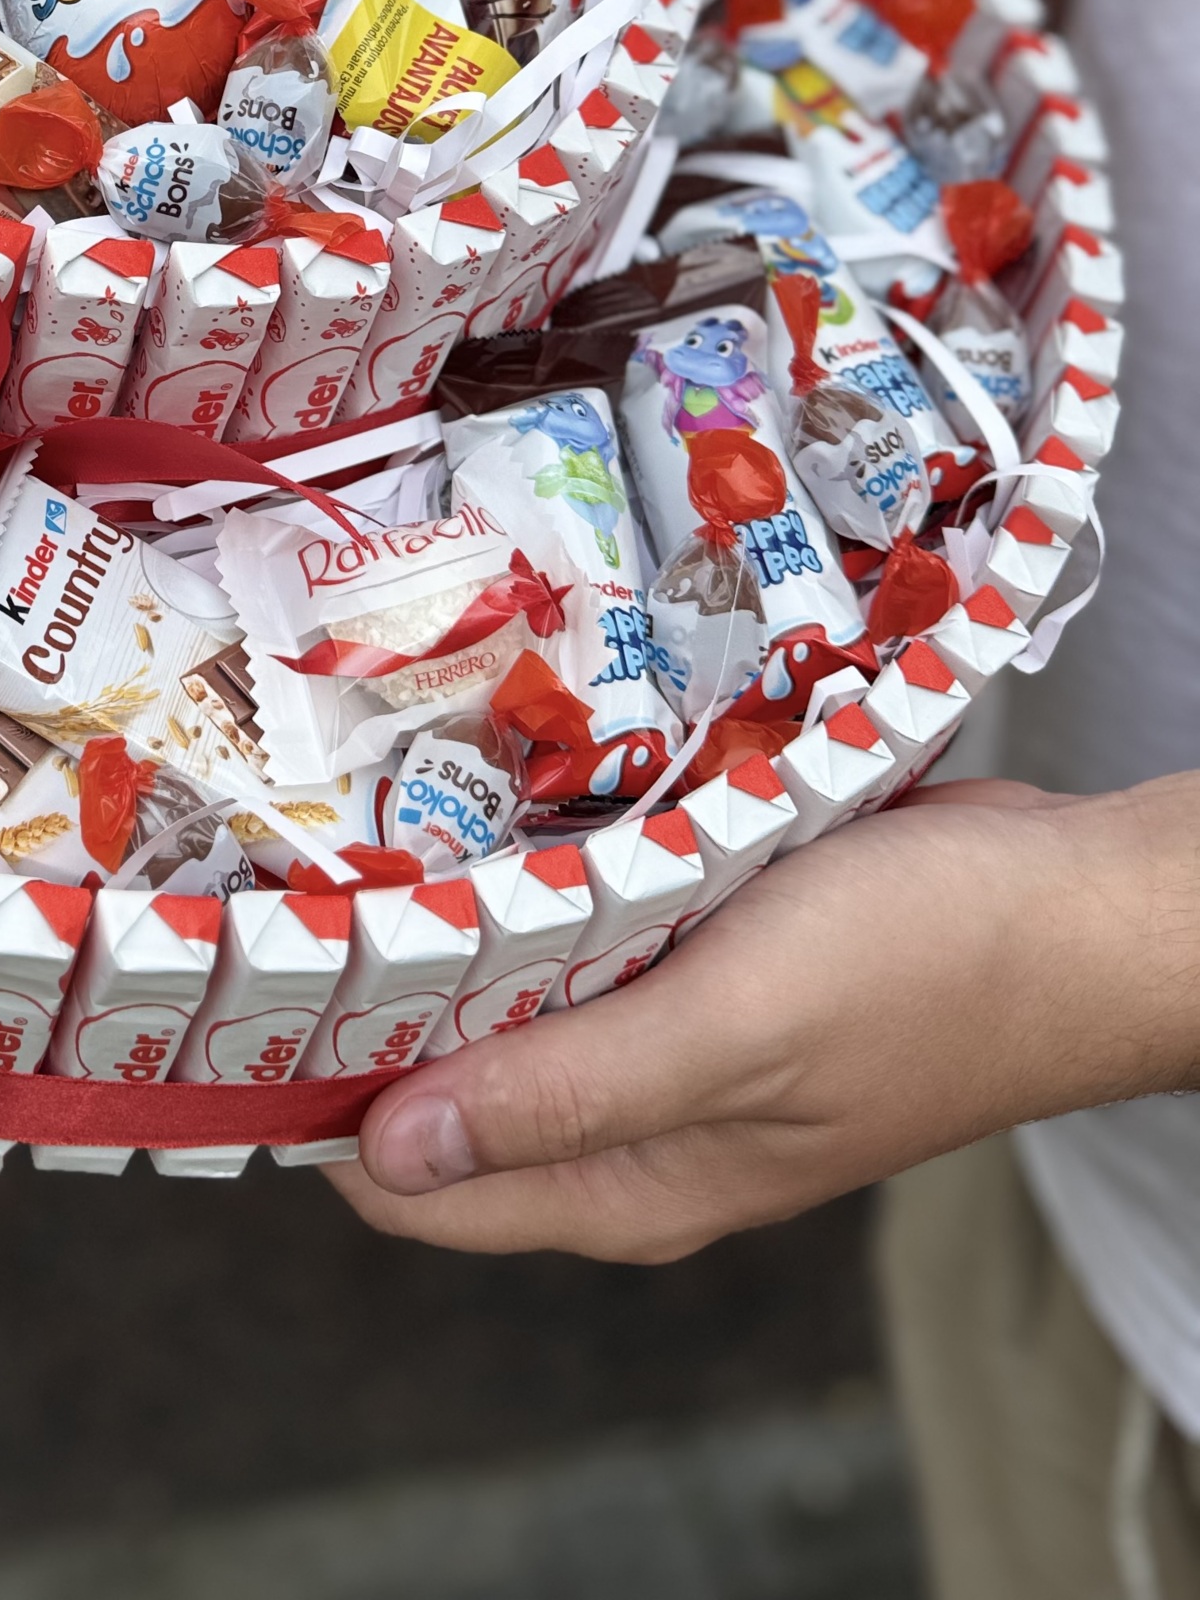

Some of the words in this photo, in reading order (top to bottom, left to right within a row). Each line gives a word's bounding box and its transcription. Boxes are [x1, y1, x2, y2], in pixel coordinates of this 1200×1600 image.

[344, 19, 383, 73] individuale
[237, 98, 297, 131] Bons
[156, 151, 195, 219] Bons
[818, 337, 880, 364] Kinder
[733, 509, 808, 549] appy
[748, 542, 823, 589] ippo
[20, 515, 136, 686] Country
[414, 651, 496, 691] FERRERO
[437, 760, 502, 822] Bons
[400, 779, 496, 858] Schoko-
[421, 821, 474, 864] Kinder
